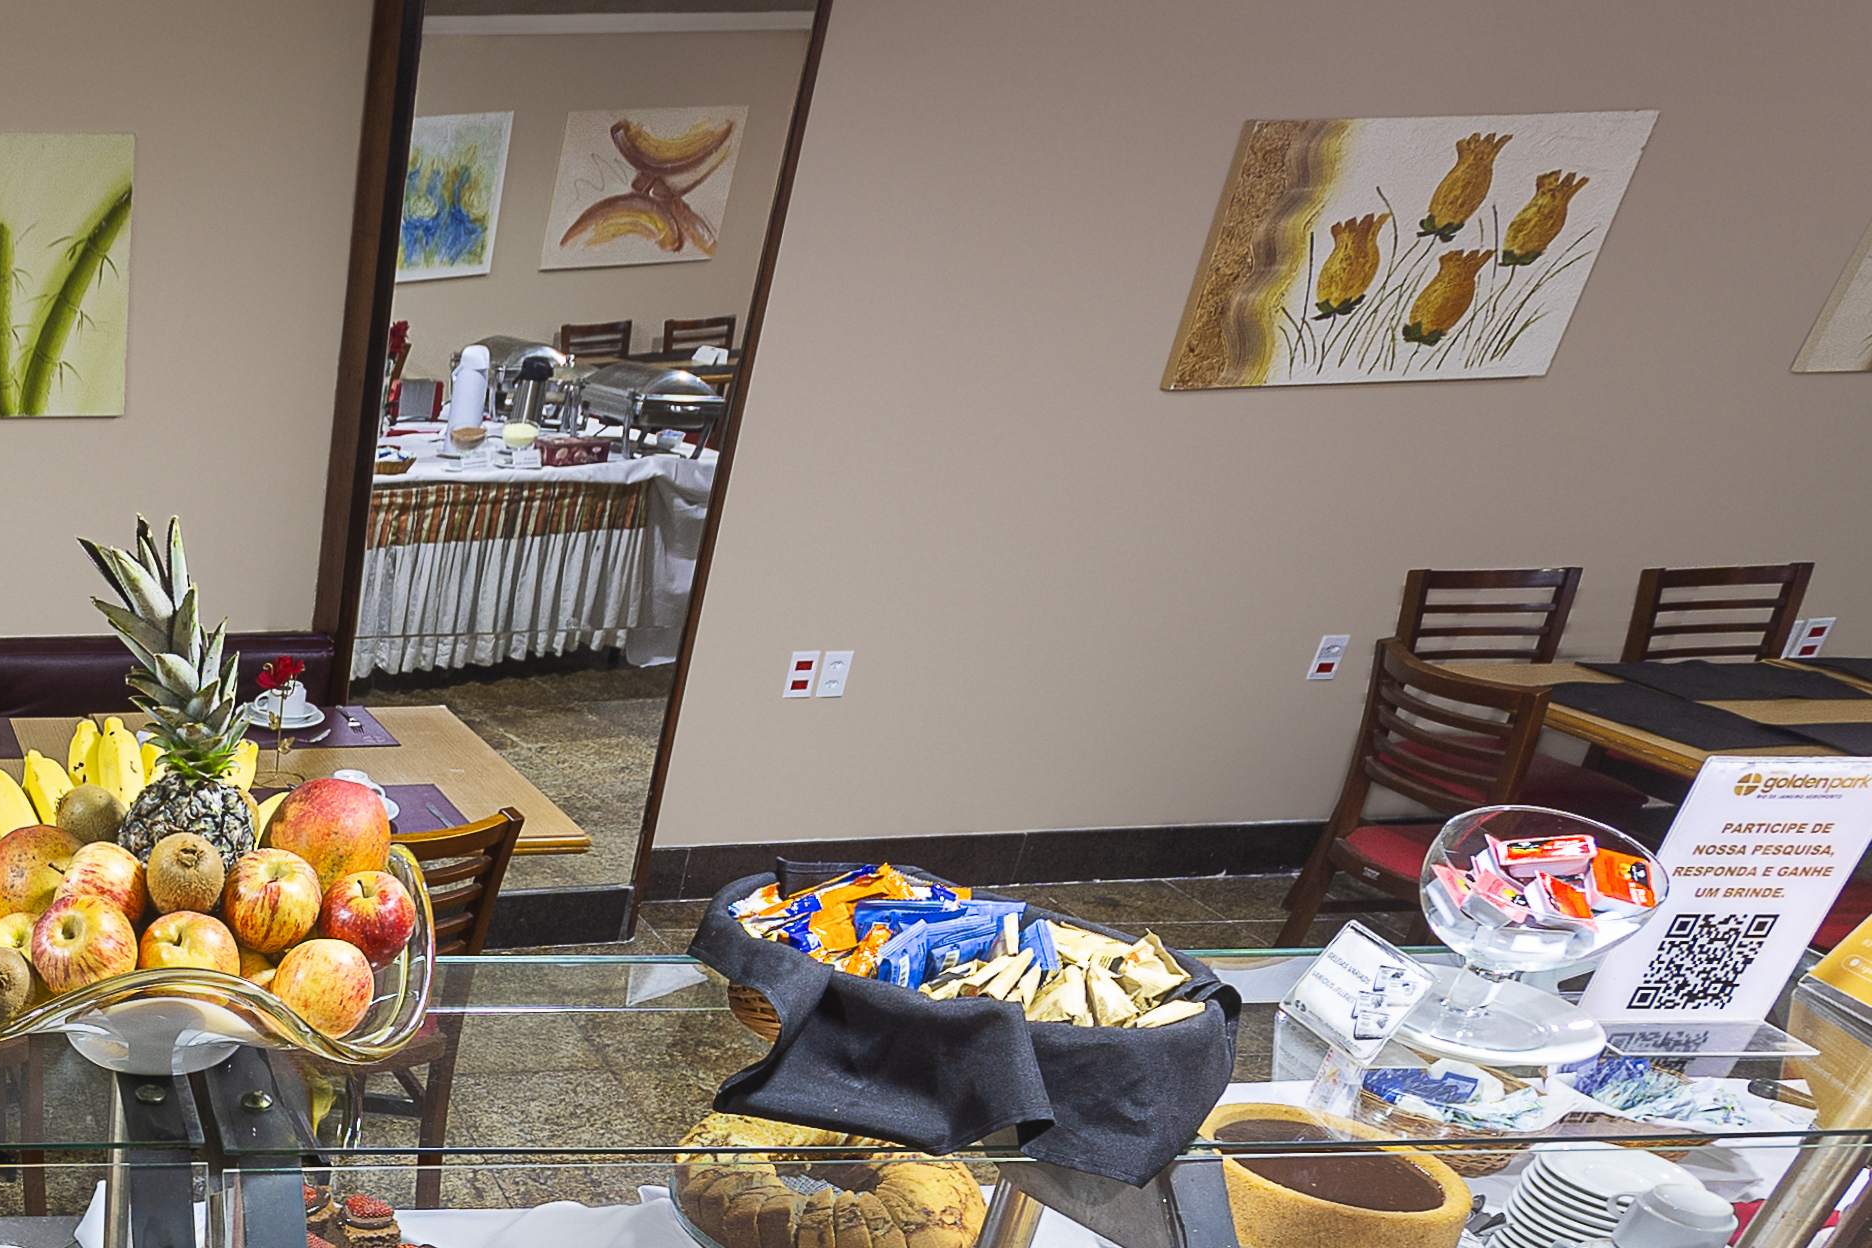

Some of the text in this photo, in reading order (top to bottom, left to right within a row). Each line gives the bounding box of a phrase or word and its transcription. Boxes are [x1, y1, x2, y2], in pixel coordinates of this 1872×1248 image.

[1721, 822, 1835, 834] PARTICIPE DE
[1692, 844, 1835, 858] NOSSA PESQUISA,
[1671, 866, 1835, 877] RESPONDA E GANHE
[1694, 887, 1785, 898] UM BRINDE.
